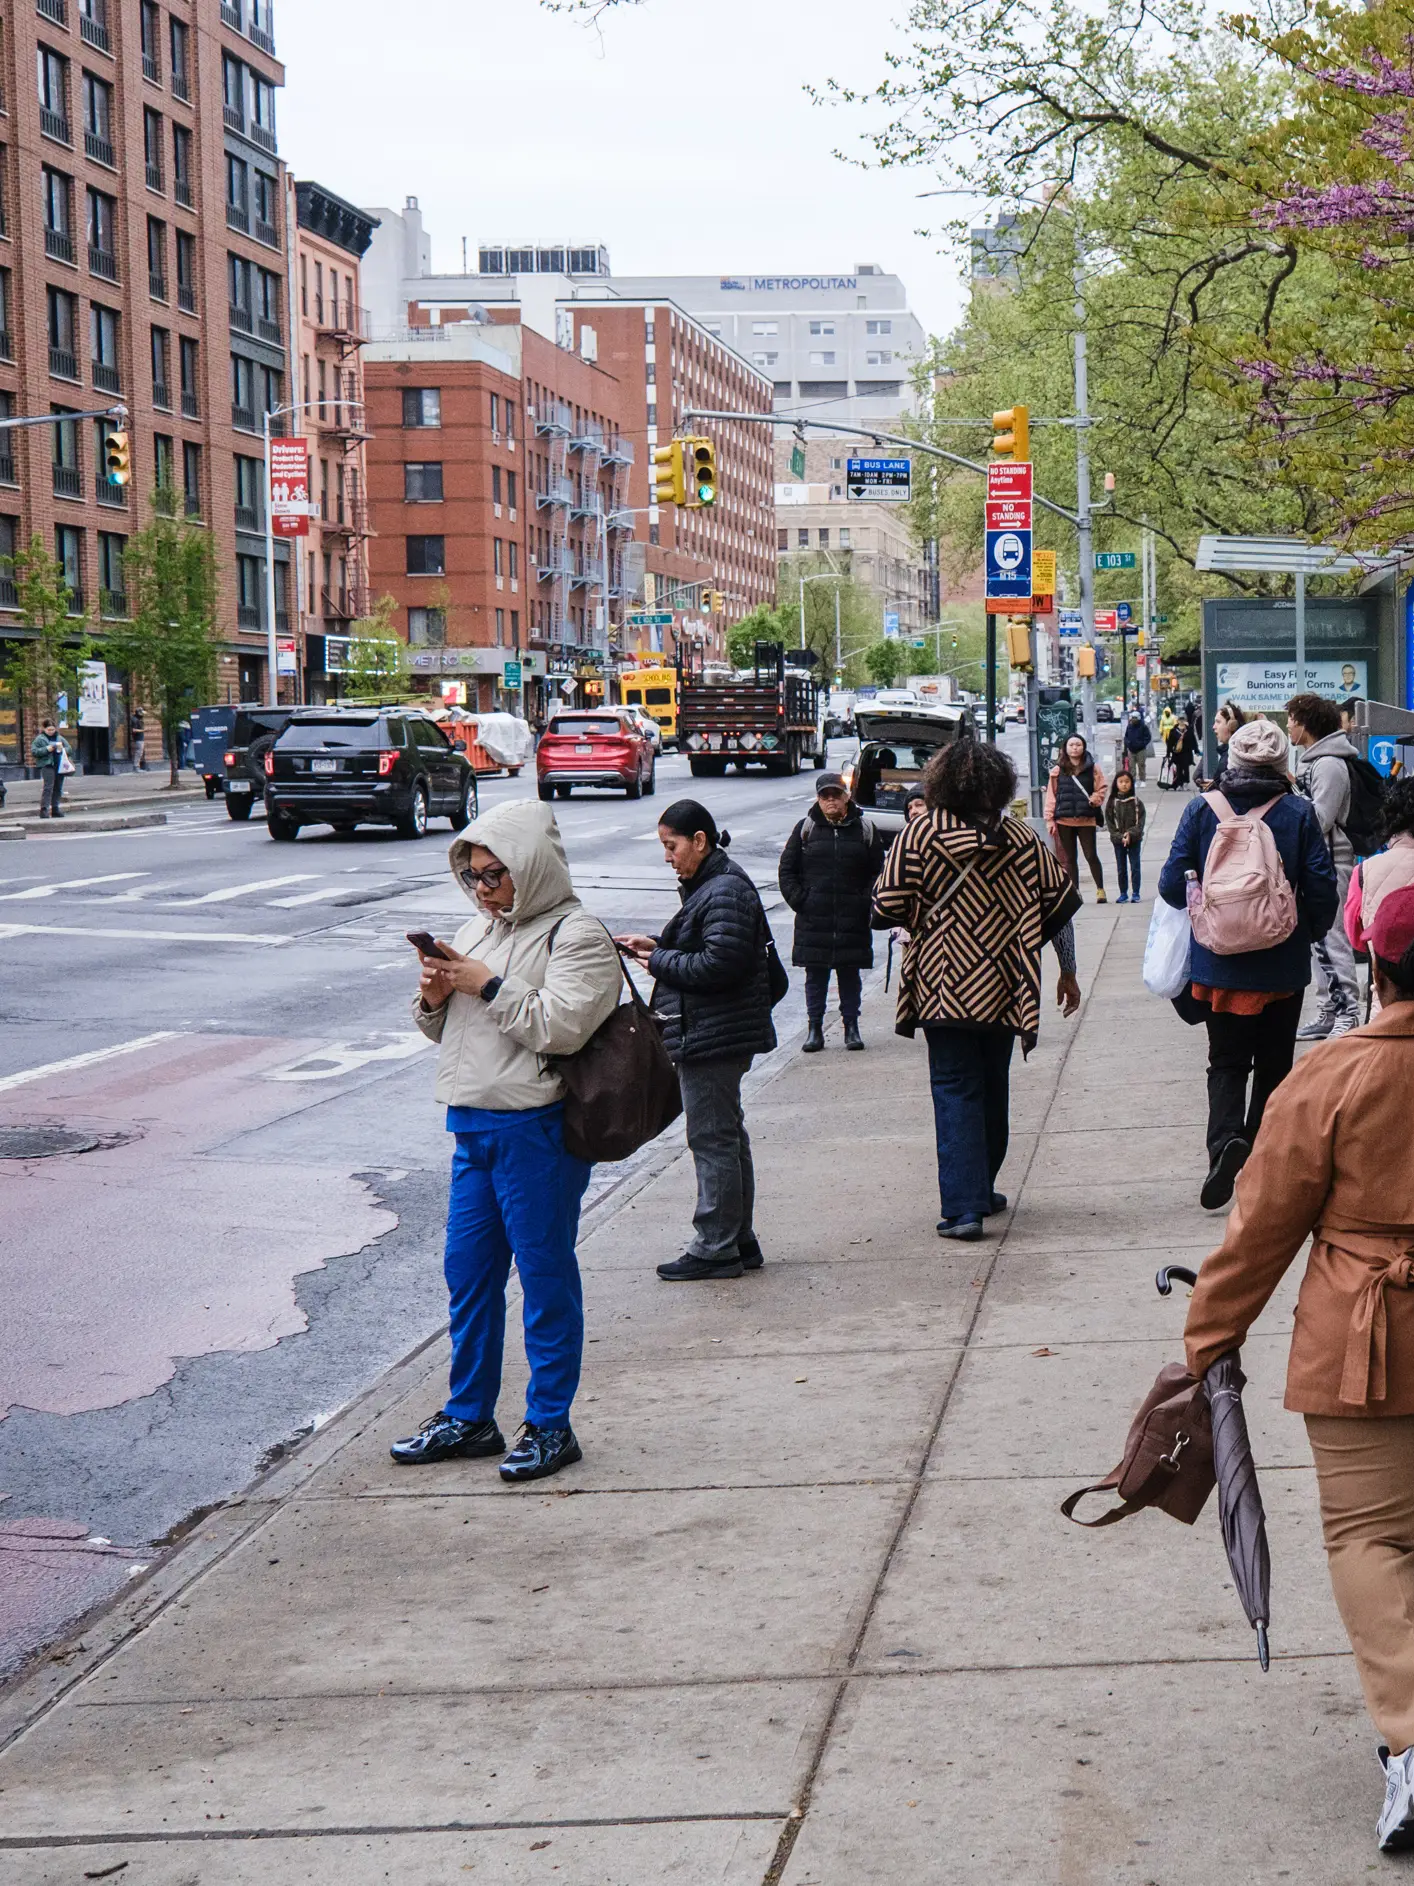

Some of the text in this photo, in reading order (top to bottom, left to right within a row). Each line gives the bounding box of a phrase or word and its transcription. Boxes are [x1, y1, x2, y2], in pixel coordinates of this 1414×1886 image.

[754, 278, 857, 289] METROPOLITAN
[272, 445, 304, 454] Drivers:
[999, 466, 1026, 475] STANDING
[990, 476, 1013, 485] Anytime
[992, 512, 1025, 520] STANDING
[1097, 555, 1102, 567] E
[1107, 554, 1121, 566] 103
[1000, 571, 1017, 580] M15
[1264, 670, 1317, 680] Easy Fi for
[1247, 681, 1285, 689] Bunions
[1306, 681, 1335, 689] Corns
[1232, 693, 1296, 701] WALK SAME DA
